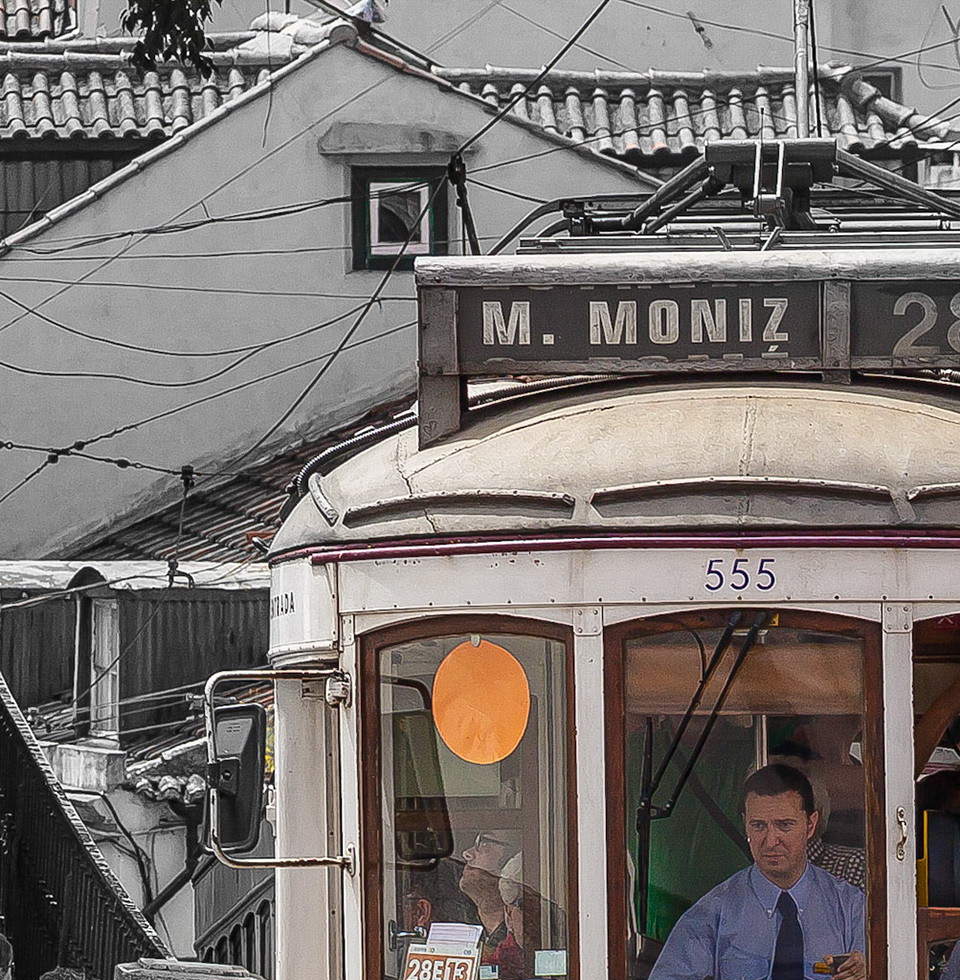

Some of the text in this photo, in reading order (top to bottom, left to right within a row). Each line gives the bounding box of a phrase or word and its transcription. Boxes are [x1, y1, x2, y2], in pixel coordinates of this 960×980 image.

[482, 297, 790, 346] M. MONIZ
[705, 558, 776, 591] 555
